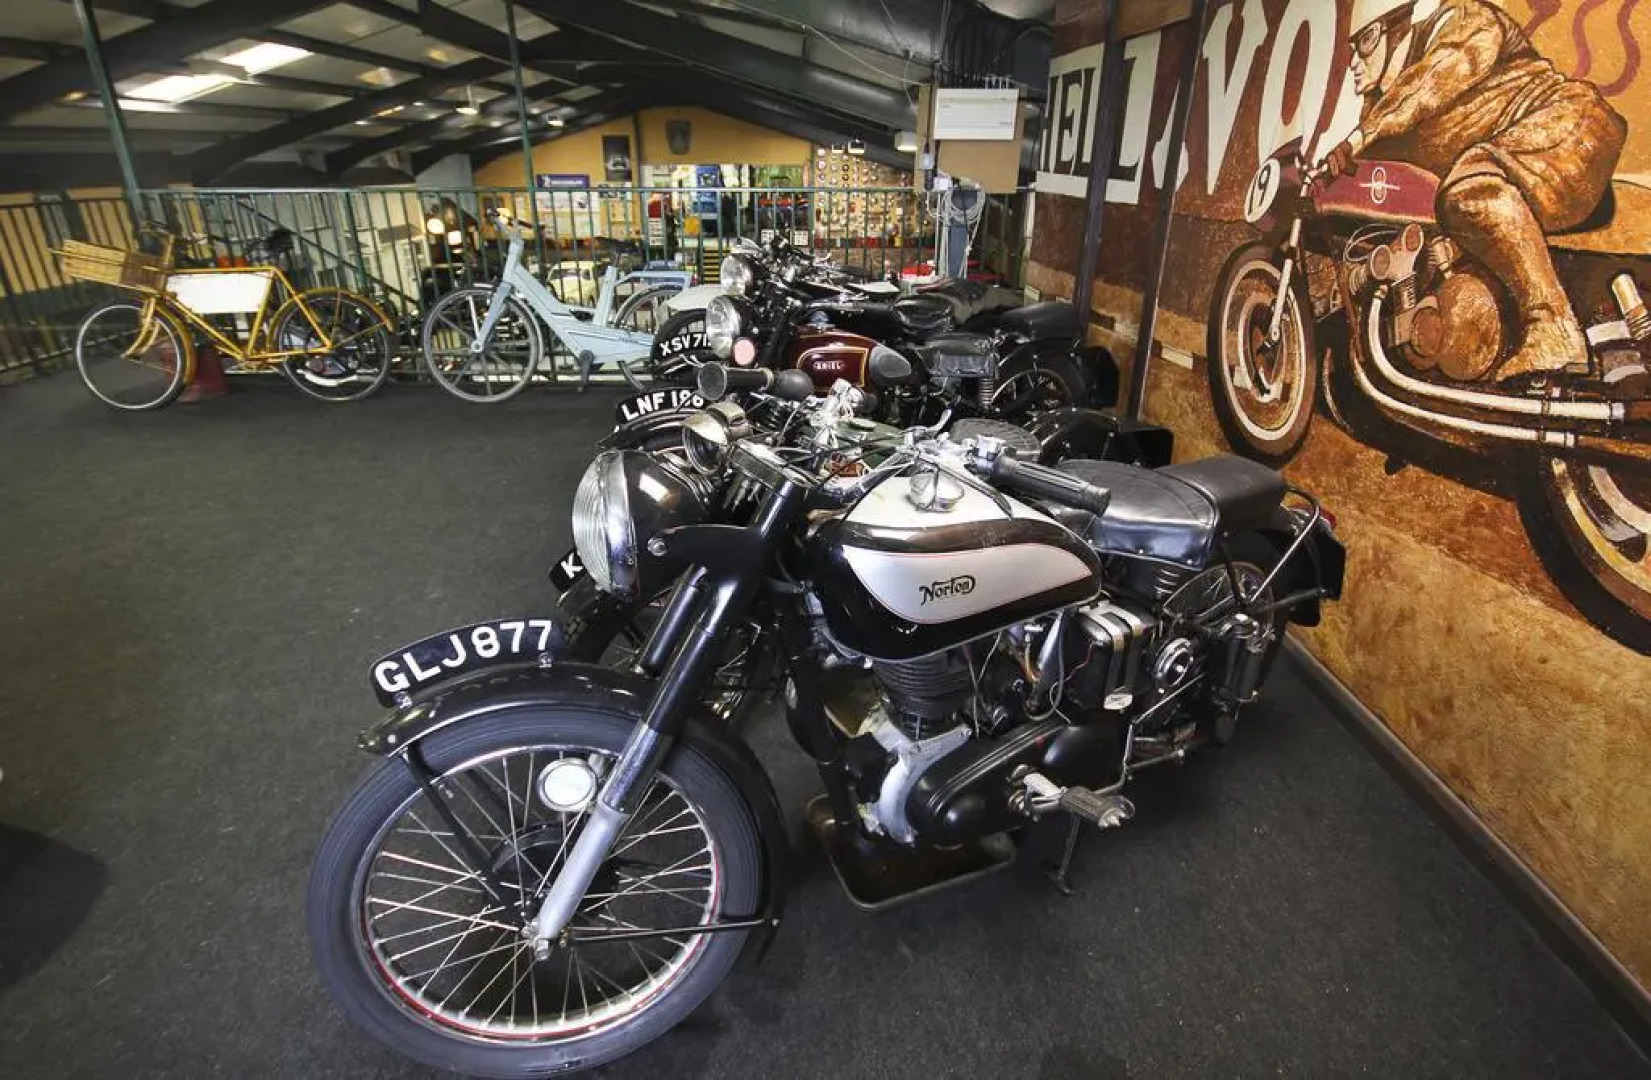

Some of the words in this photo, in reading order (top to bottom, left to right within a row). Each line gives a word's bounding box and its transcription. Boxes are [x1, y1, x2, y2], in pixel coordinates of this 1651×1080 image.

[1246, 163, 1272, 217] 19
[621, 391, 665, 421] LNF
[919, 574, 977, 607] Norton
[374, 619, 553, 694] GLJ877
